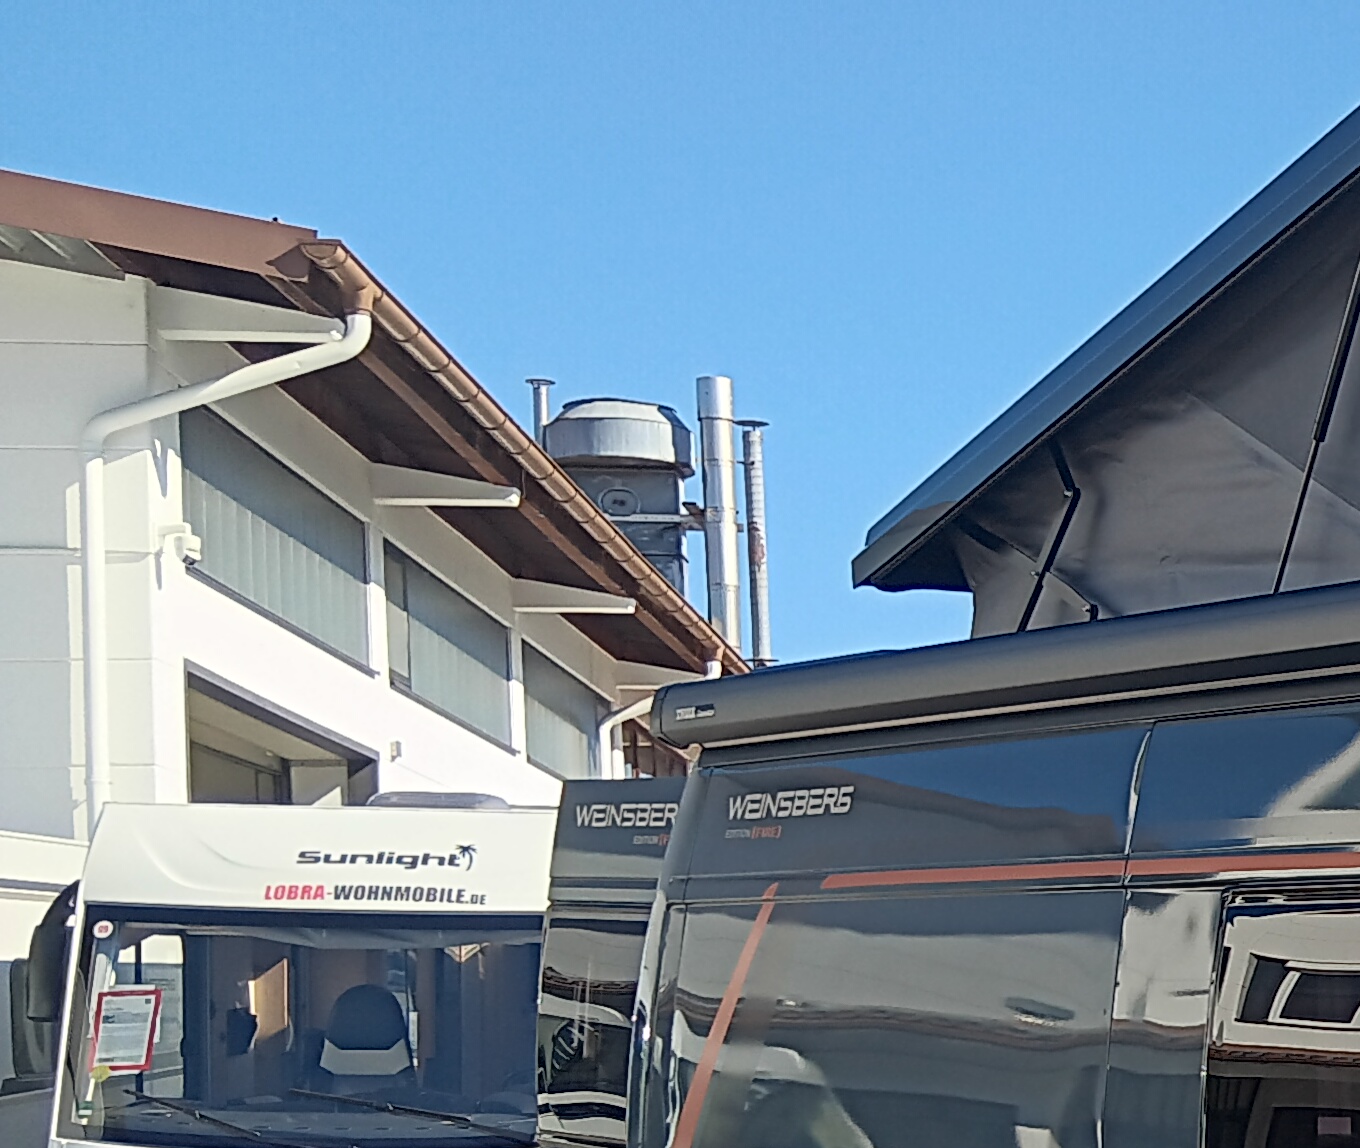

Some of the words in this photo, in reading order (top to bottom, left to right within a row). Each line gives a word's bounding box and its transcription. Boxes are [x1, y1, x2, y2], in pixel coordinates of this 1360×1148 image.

[728, 785, 855, 820] WEINSBERG
[575, 803, 679, 827] WEINSBER
[296, 851, 461, 870] Sunlight
